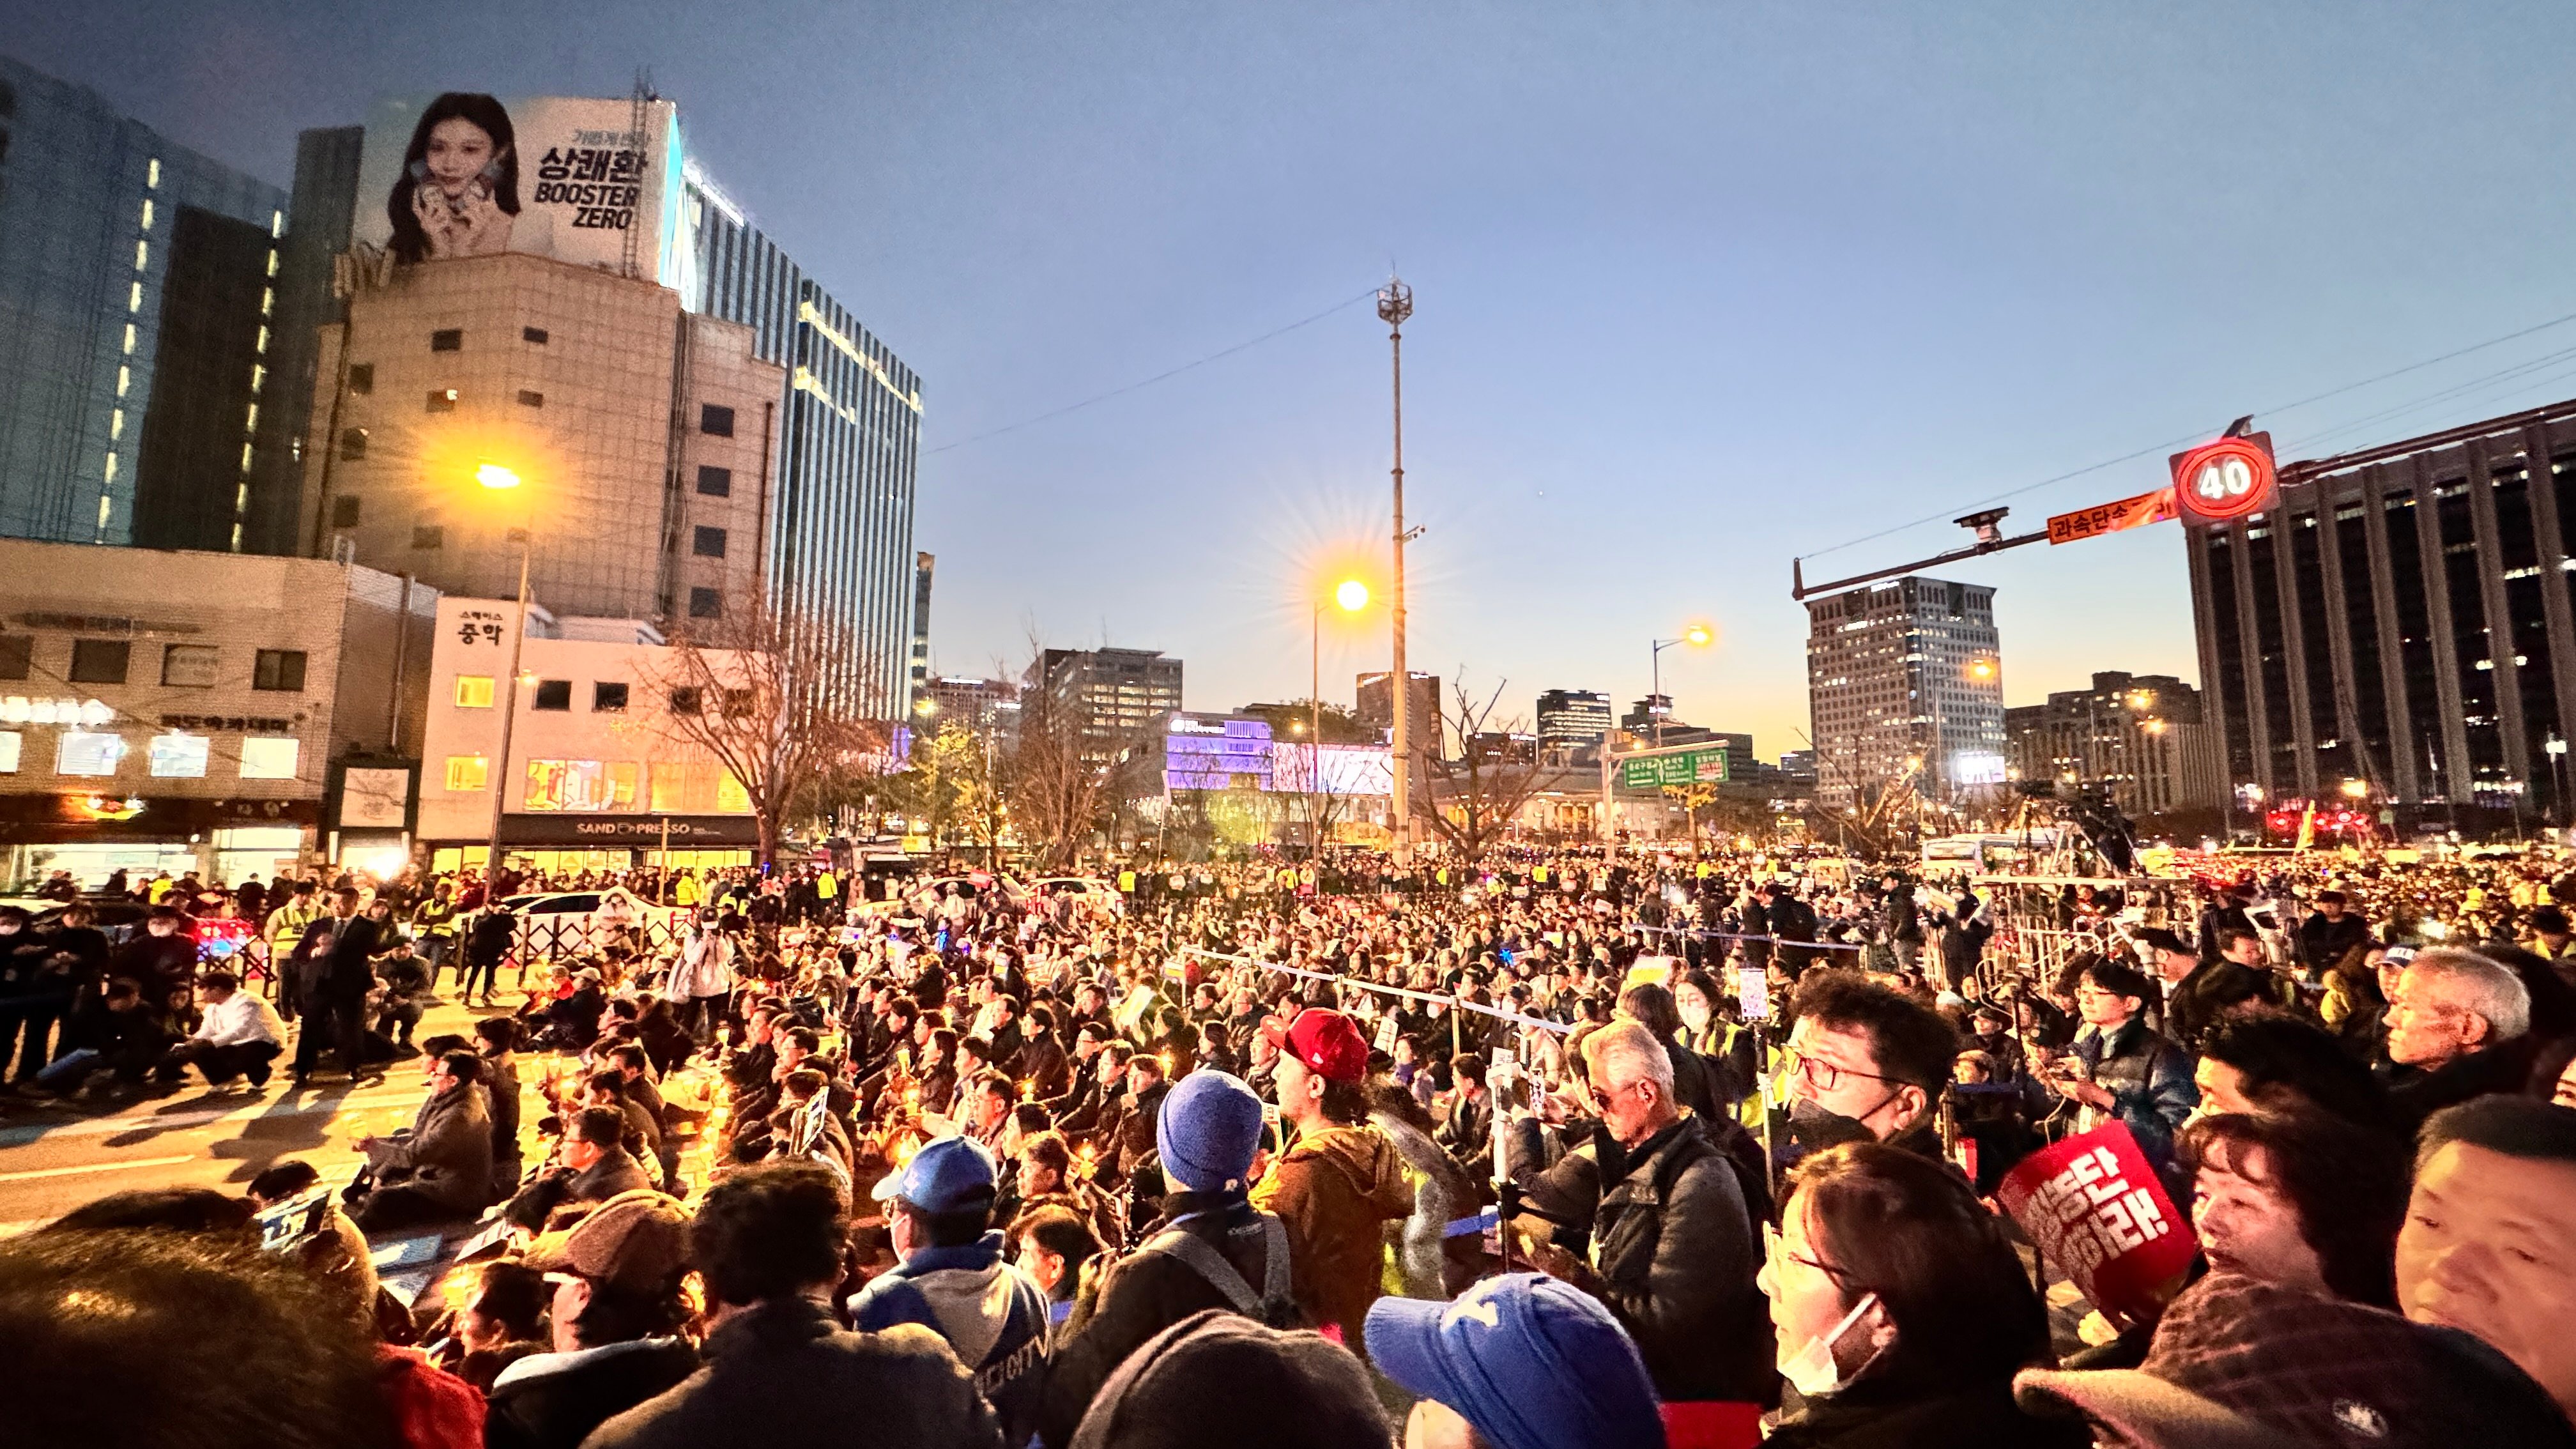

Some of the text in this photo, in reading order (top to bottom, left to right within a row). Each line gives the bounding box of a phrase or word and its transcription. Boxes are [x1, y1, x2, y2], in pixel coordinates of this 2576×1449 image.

[534, 182, 639, 207] BOOSTER
[572, 206, 633, 229] ZERO
[2200, 461, 2251, 500] 40
[459, 611, 503, 620] 스페이스
[458, 624, 503, 646] 중학
[577, 822, 616, 834] SAND
